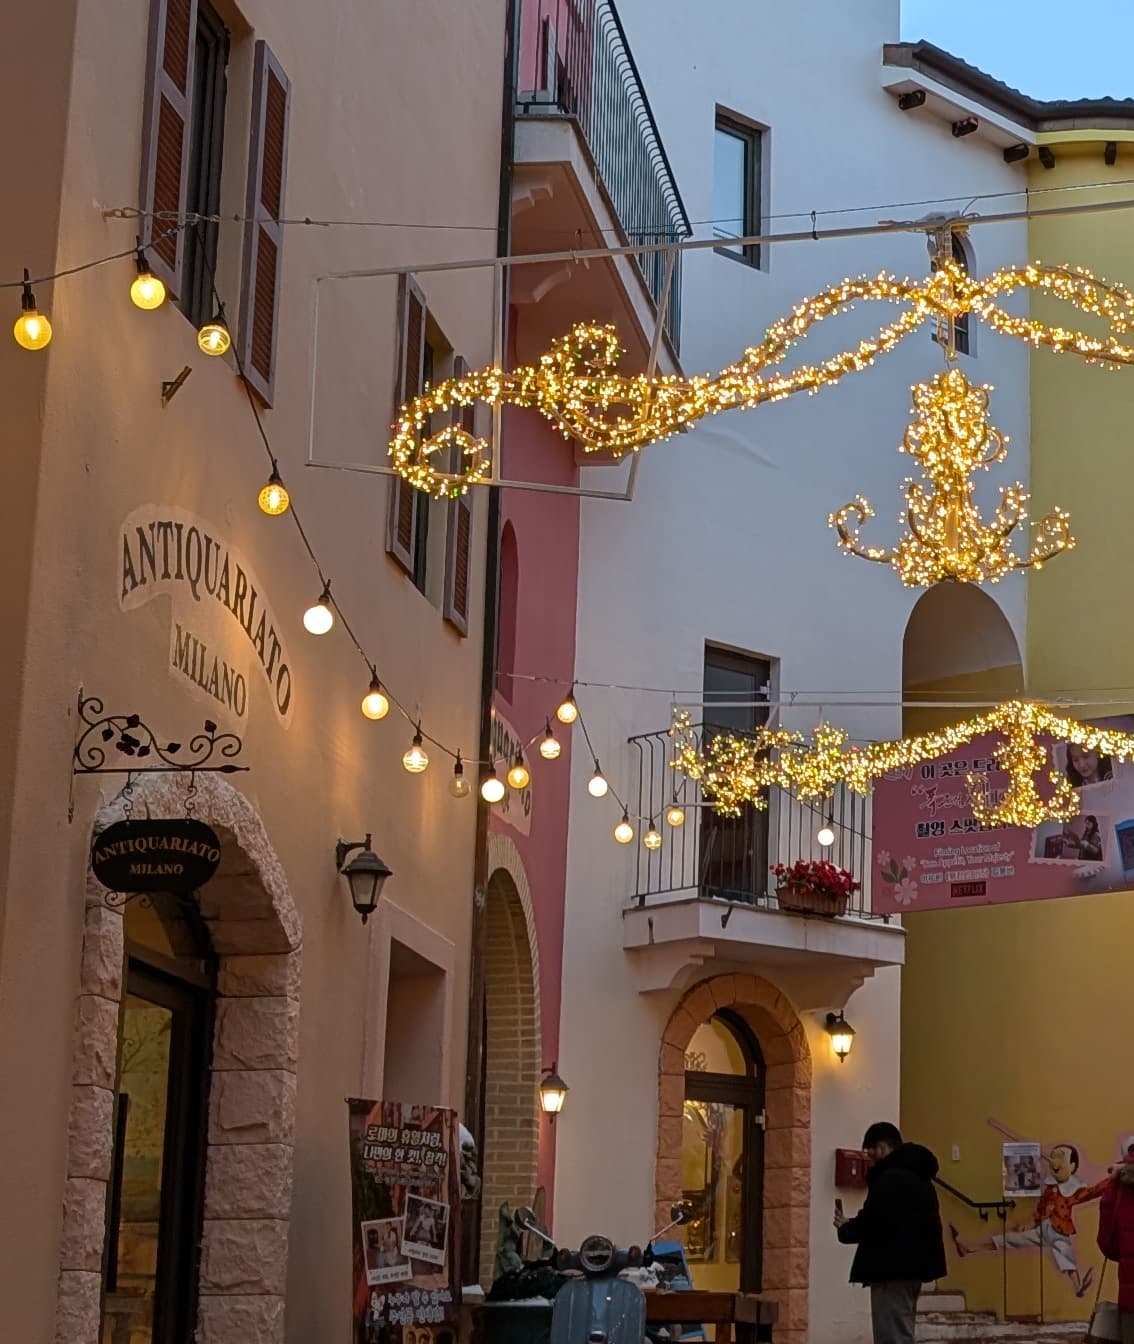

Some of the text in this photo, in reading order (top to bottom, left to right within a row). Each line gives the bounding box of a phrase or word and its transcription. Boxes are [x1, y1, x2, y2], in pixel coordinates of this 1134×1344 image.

[121, 520, 292, 716] ANTIQUARIATO
[172, 623, 247, 718] MILANO
[921, 764, 935, 779] 이
[940, 759, 968, 777] 곳은
[95, 836, 220, 864] ANTIQUARIATO
[129, 863, 184, 875] MILANO
[952, 885, 984, 896] NETFLIX
[367, 1126, 398, 1143] 로마의
[364, 1145, 393, 1161] 나만의
[394, 1148, 405, 1162] 한
